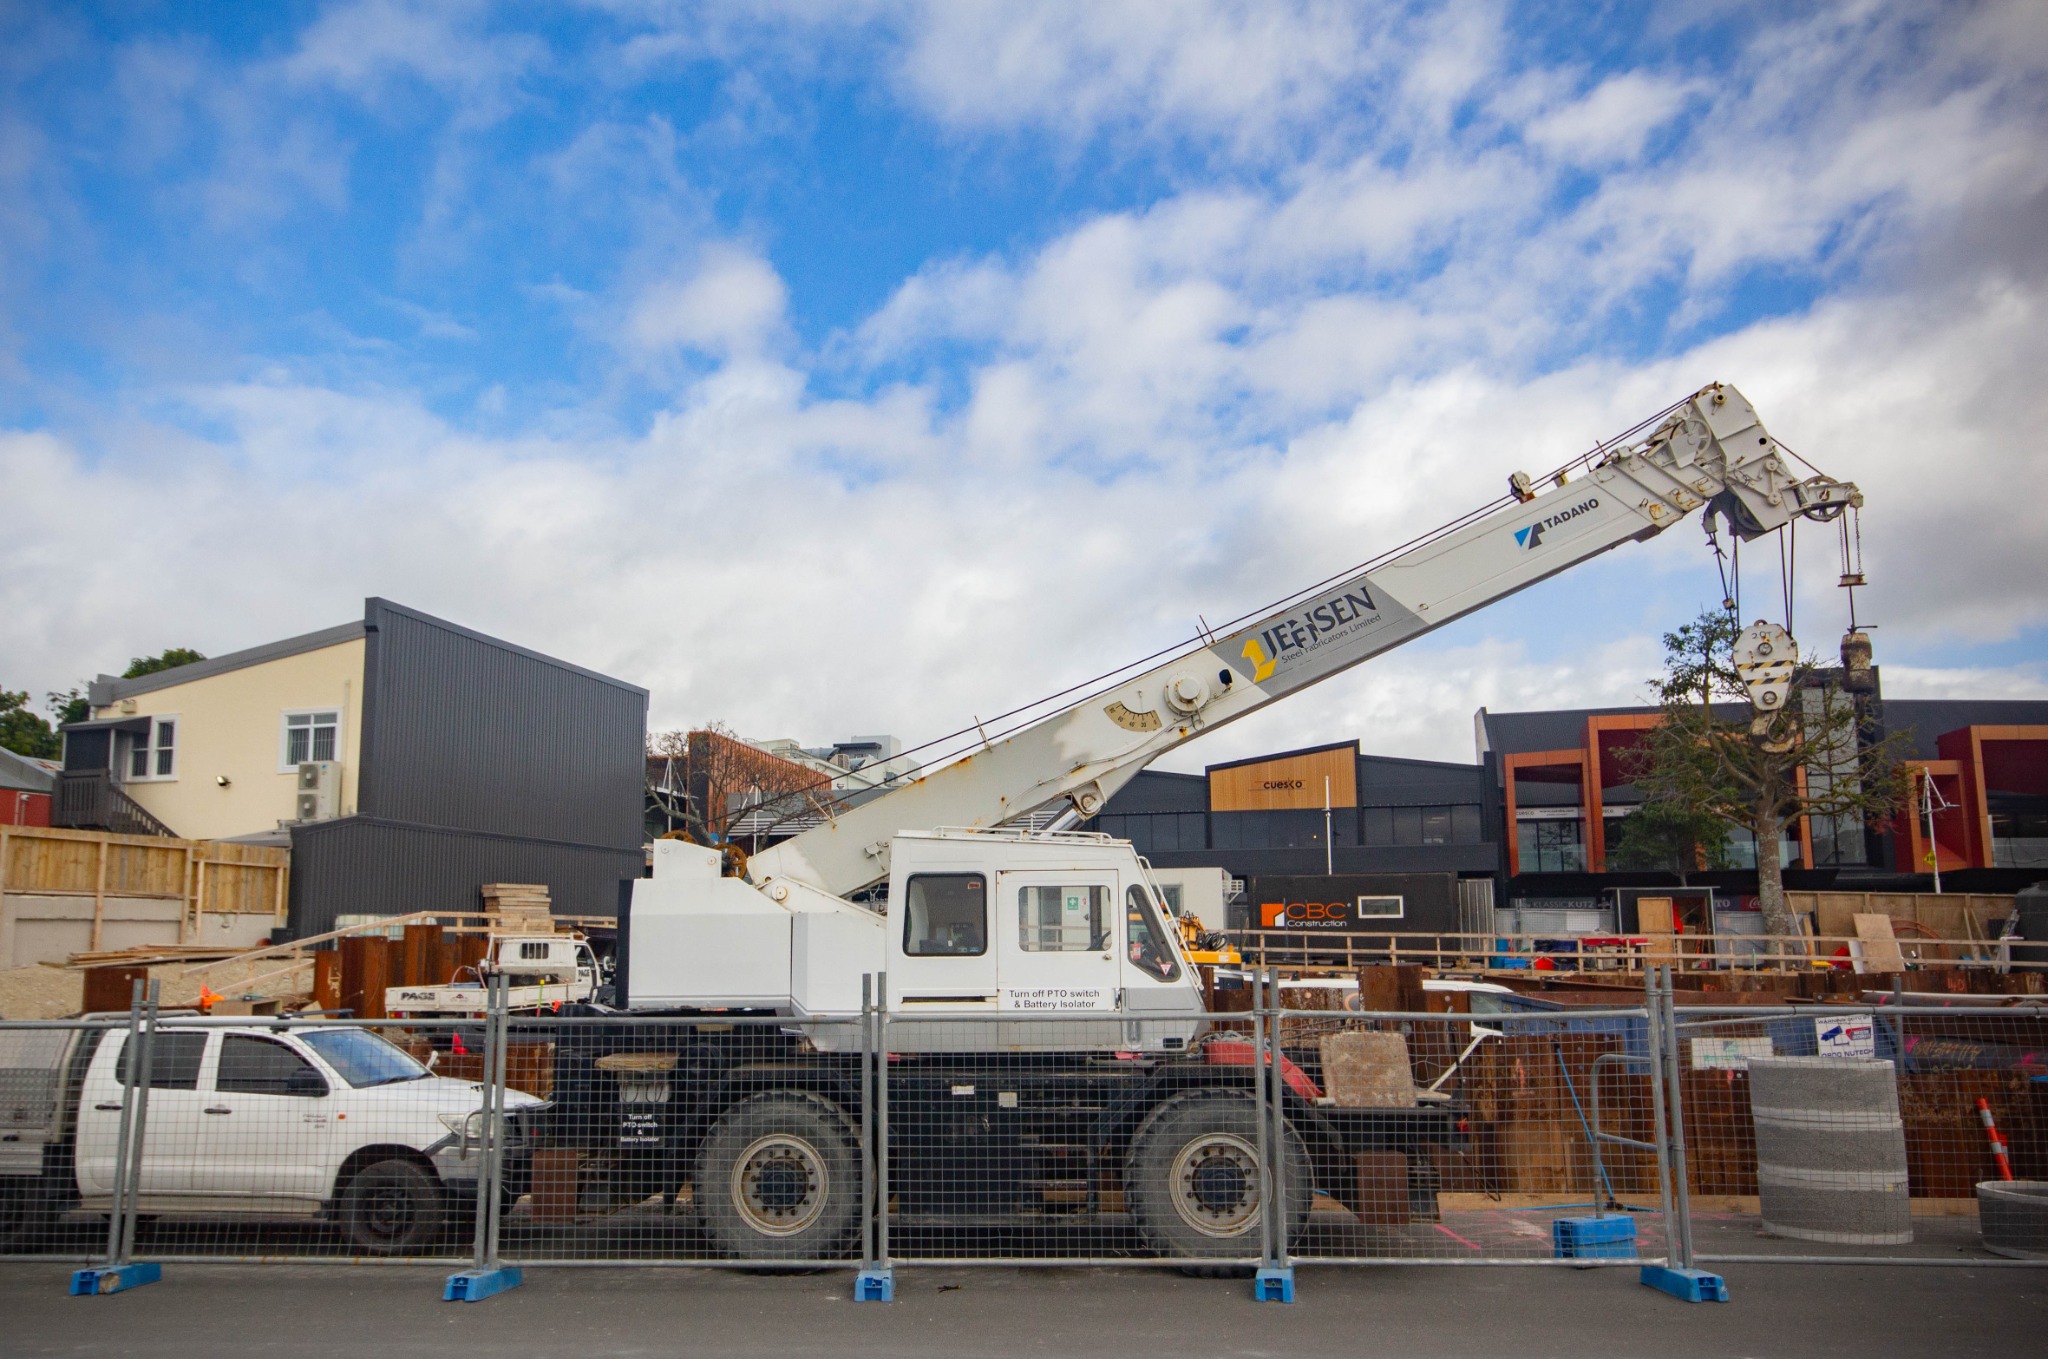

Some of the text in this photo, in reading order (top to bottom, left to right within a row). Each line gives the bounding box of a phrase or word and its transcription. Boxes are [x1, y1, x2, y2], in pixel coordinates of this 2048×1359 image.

[1544, 498, 1599, 528] TADANO
[1281, 650, 1304, 663] Steel
[1349, 613, 1382, 633] Limited
[1286, 902, 1346, 919] CBC
[1287, 919, 1347, 927] Construction
[401, 992, 436, 1001] PAGE
[1009, 989, 1100, 998] Turn off PTO switch
[1014, 1000, 1096, 1010] & Battery Isolator
[1844, 1048, 1874, 1057] NUTECH
